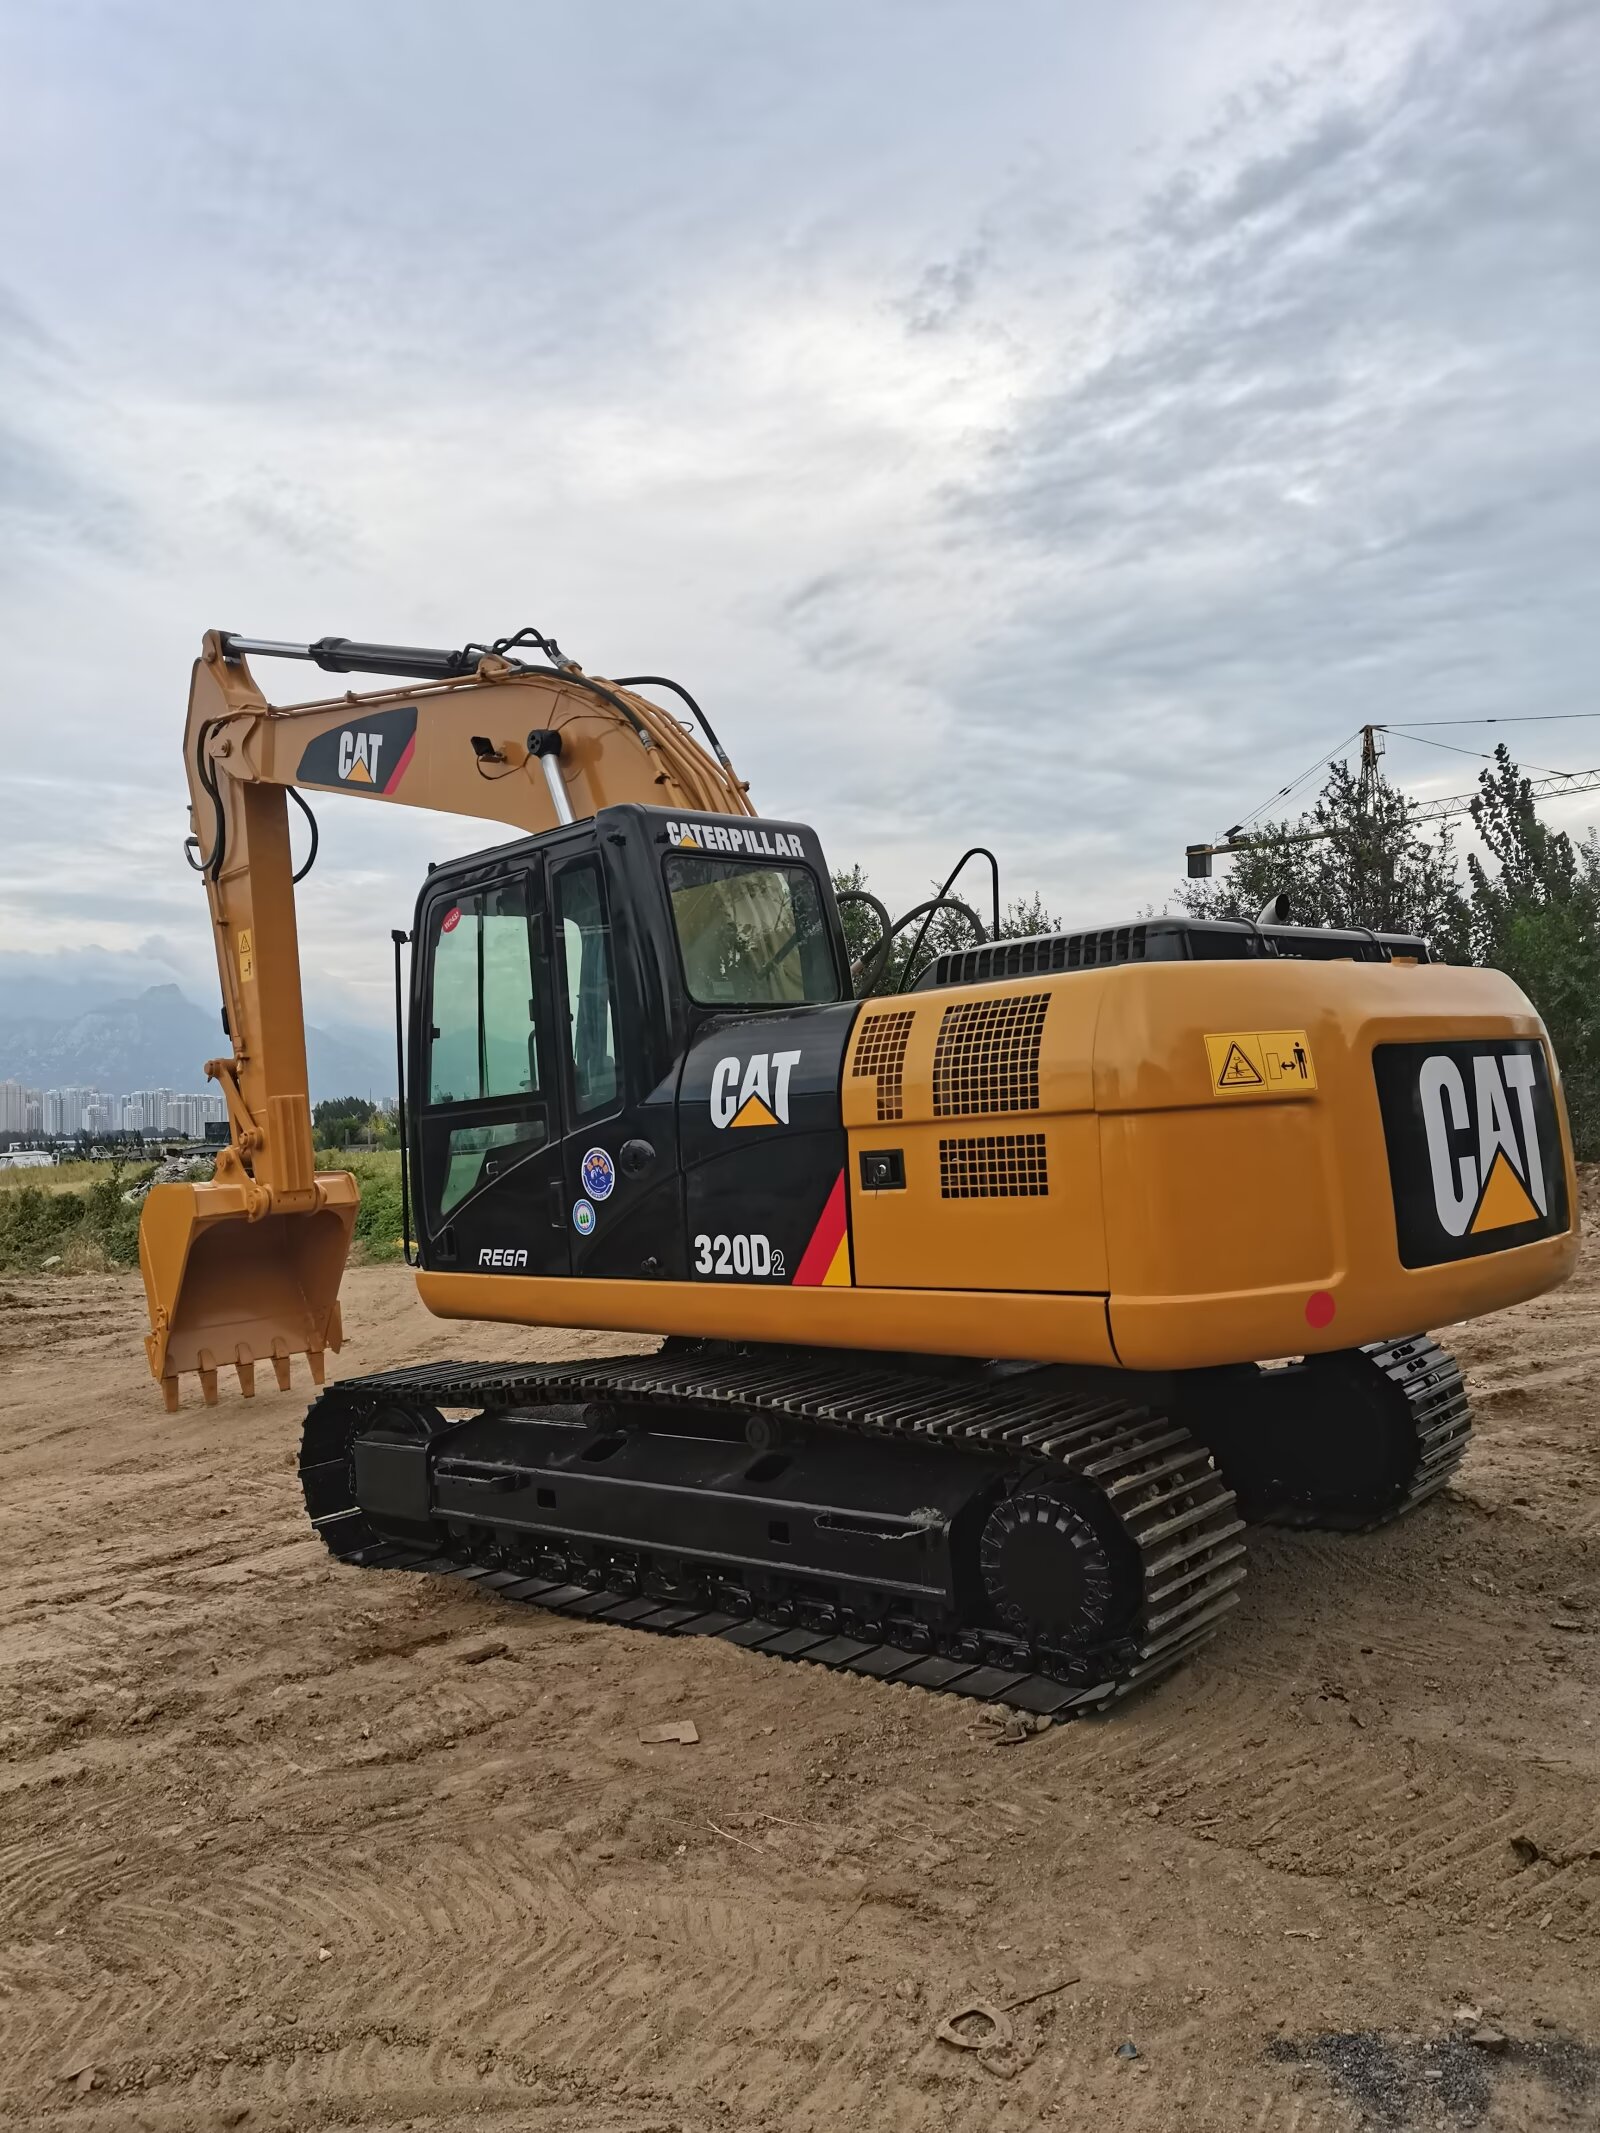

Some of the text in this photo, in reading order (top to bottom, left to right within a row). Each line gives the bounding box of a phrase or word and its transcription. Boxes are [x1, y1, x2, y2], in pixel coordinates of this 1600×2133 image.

[338, 731, 383, 783] CAT
[666, 821, 805, 857] CATERPILLAR
[710, 1050, 801, 1129] CAT
[1419, 1054, 1548, 1237] CAT
[478, 1249, 528, 1267] REGA
